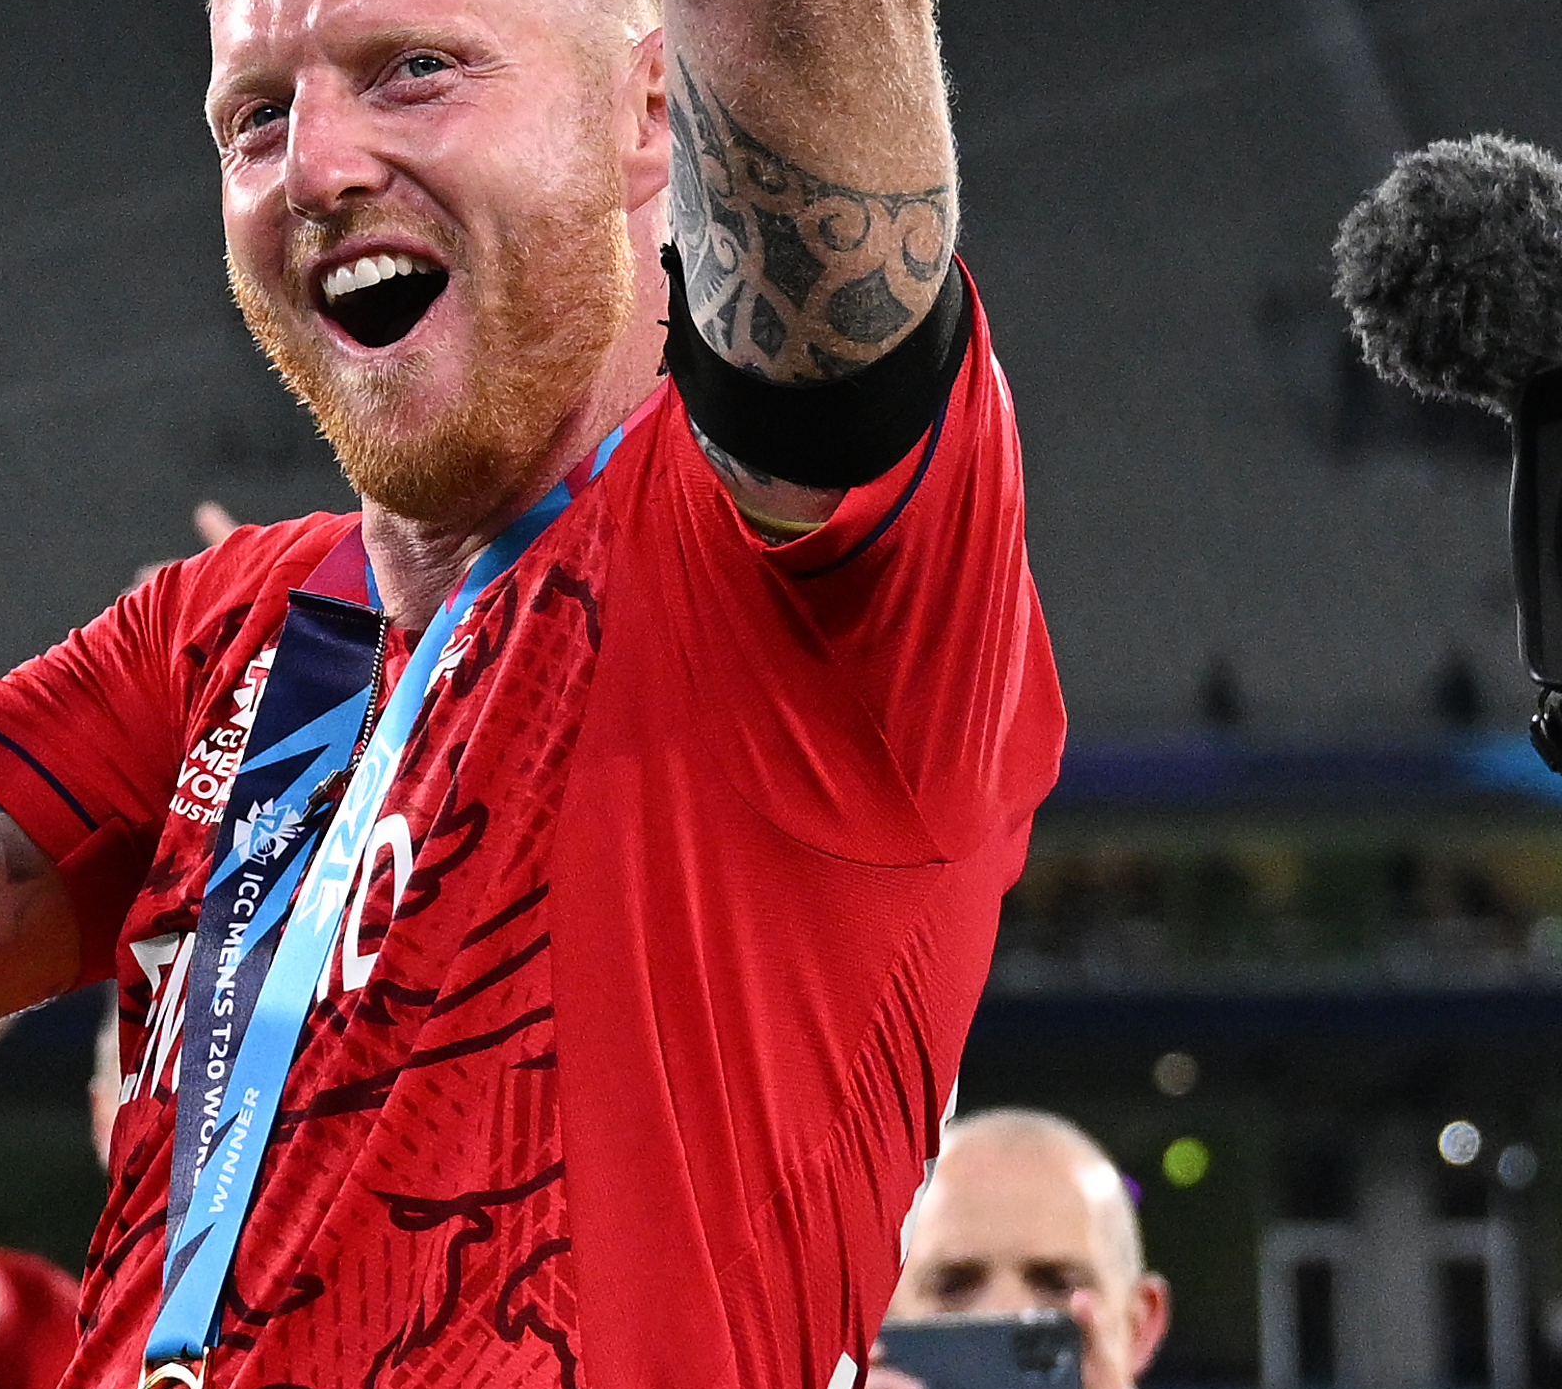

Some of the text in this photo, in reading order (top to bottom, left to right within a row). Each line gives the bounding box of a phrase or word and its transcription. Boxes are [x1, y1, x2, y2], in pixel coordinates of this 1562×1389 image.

[189, 739, 244, 777] ME
[209, 727, 242, 747] ICC
[193, 871, 265, 1185] ICC MEN'S T20 WOR
[208, 1087, 260, 1213] WINNER
